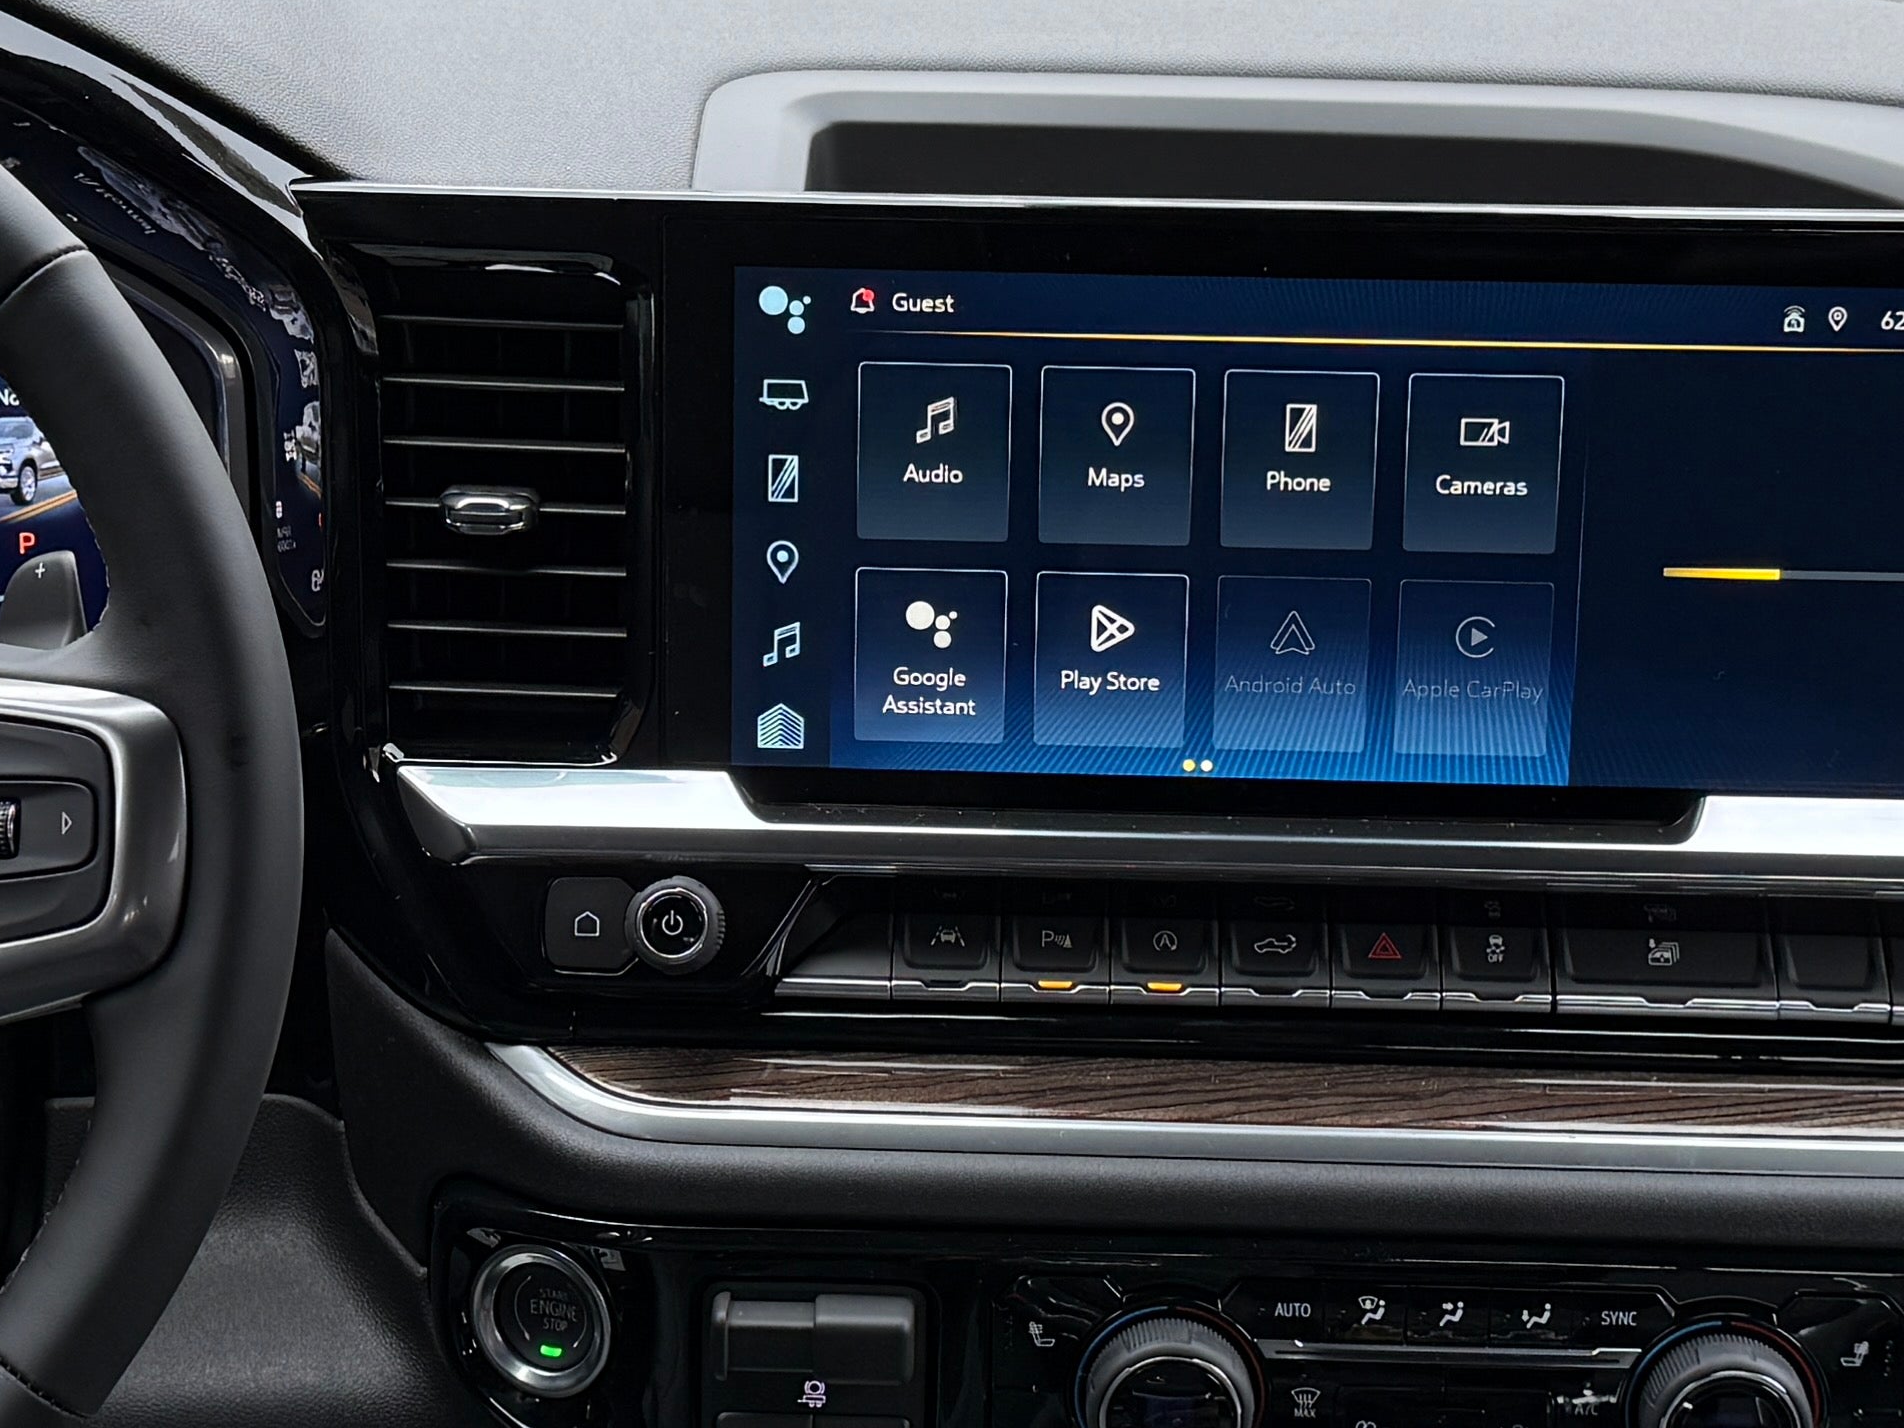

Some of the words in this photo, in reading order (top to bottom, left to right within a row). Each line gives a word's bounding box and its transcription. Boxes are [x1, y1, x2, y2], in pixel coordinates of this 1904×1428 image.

[892, 292, 956, 314] Guest
[903, 463, 963, 484] Audio
[1087, 466, 1146, 492] Maps
[1266, 470, 1332, 493] Phone
[1435, 474, 1529, 497] Cameras
[18, 532, 36, 554] P
[893, 666, 966, 692] Google
[1060, 669, 1102, 696] Play
[1105, 671, 1160, 692] Store
[1224, 674, 1303, 695] Android
[1308, 676, 1356, 696] Auto
[1402, 677, 1460, 701] Apple
[1466, 679, 1544, 705] CarPlay
[882, 694, 976, 716] Assistant
[1487, 953, 1505, 963] OFF
[530, 1299, 578, 1322] ENGINE
[1274, 1303, 1311, 1318] AUTO
[1601, 1311, 1638, 1327] SYNC
[543, 1317, 569, 1332] STOP
